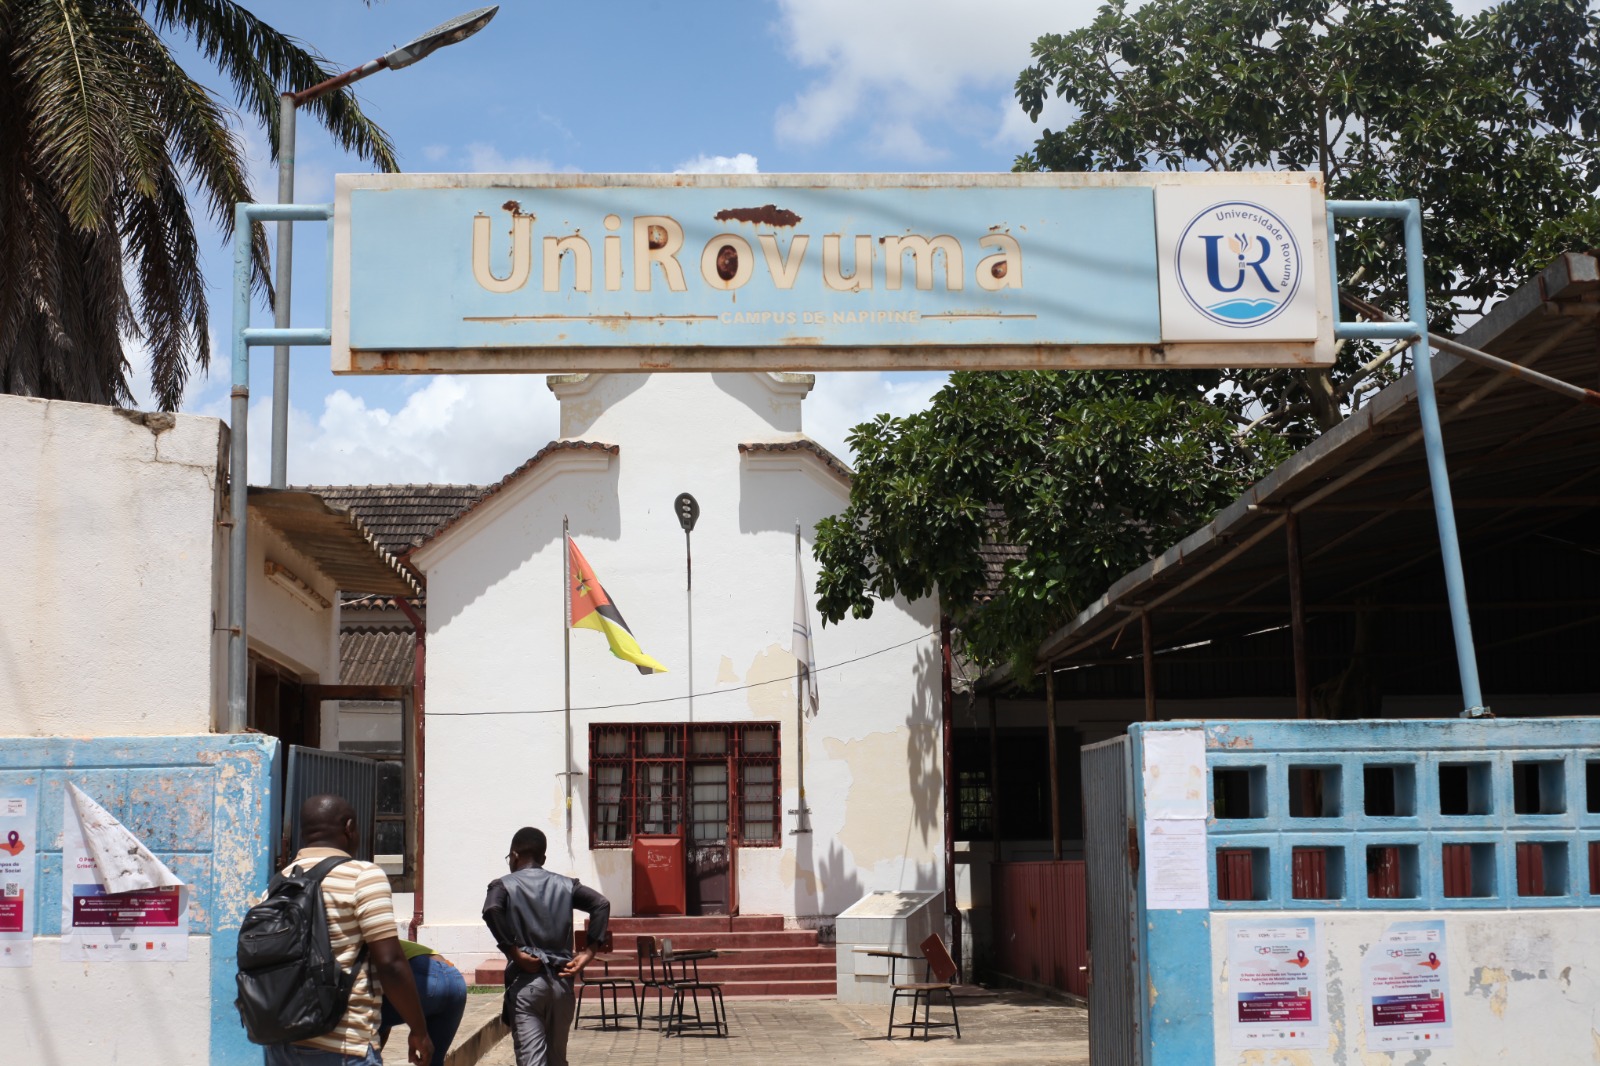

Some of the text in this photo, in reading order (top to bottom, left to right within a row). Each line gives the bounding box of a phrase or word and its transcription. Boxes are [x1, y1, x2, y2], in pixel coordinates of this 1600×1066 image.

[471, 213, 1024, 293] UniRovuma
[1215, 209, 1291, 288] Universidade Rovuma
[721, 310, 920, 325] CAMPUS DE NAPIPINE
